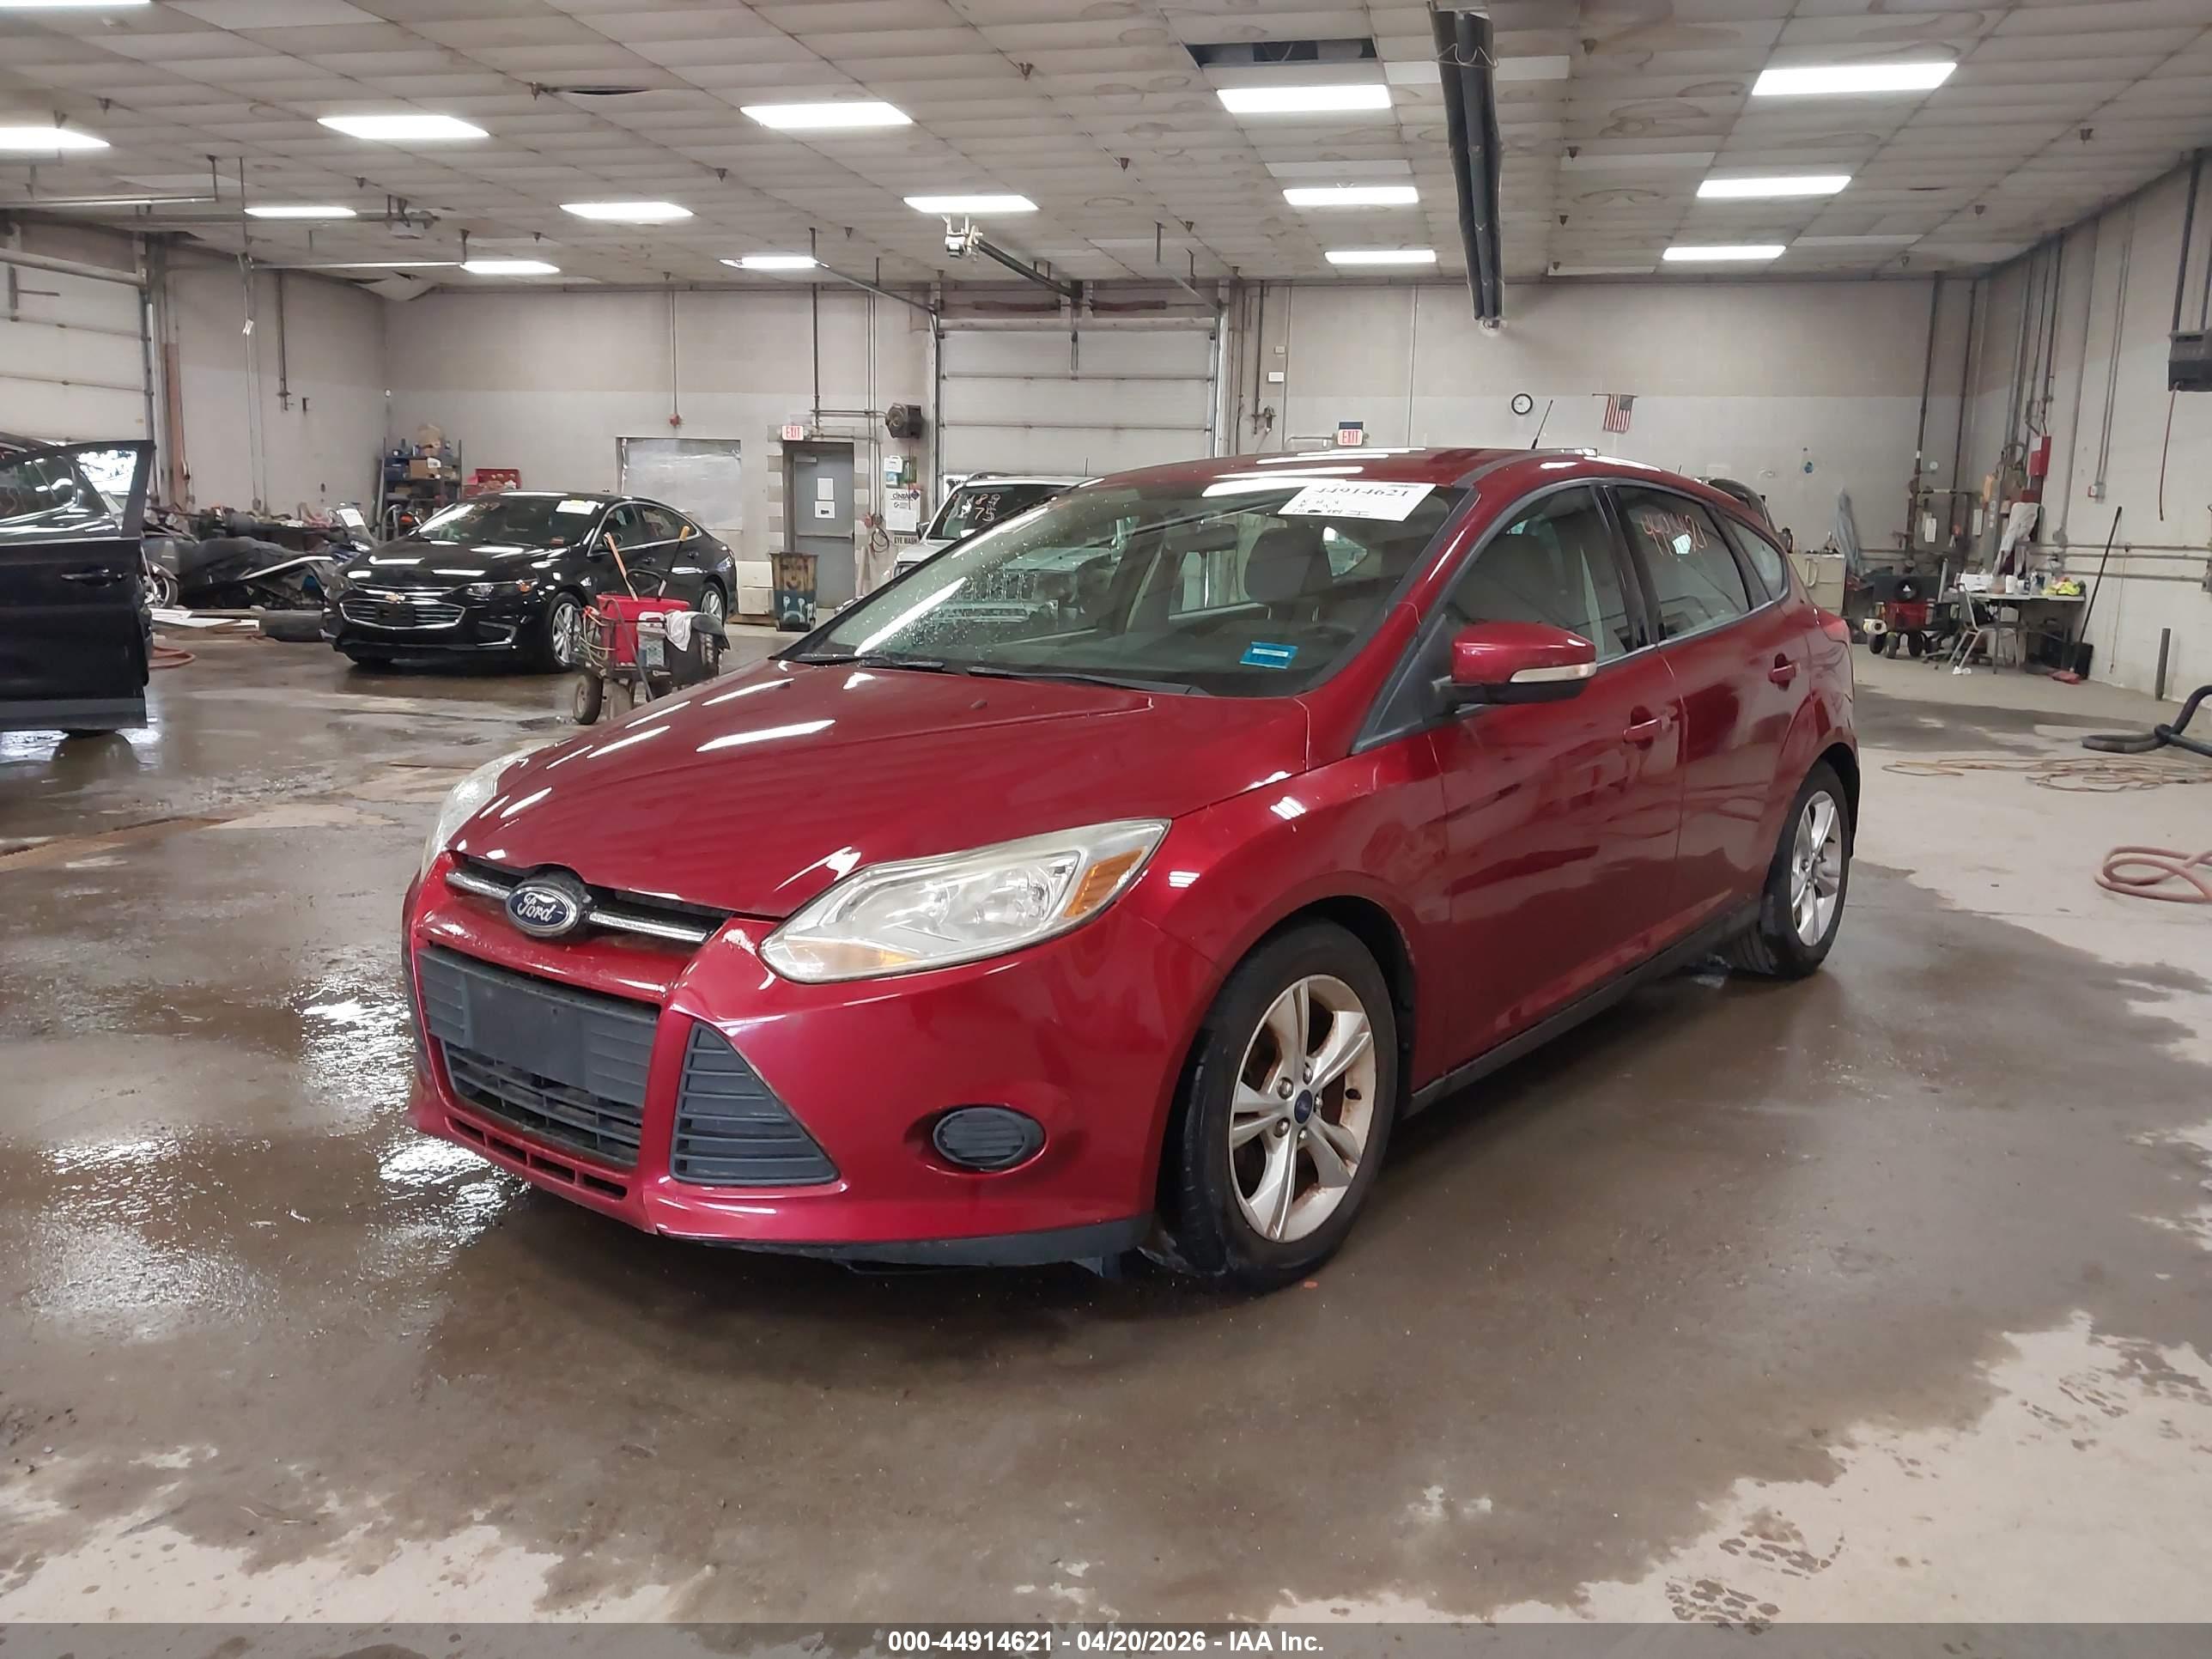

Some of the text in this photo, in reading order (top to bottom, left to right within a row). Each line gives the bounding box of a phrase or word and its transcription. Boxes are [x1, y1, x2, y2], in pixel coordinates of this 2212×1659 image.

[786, 427, 800, 438] EXIT
[1342, 430, 1359, 444] EXIT
[517, 892, 557, 922] Ford
